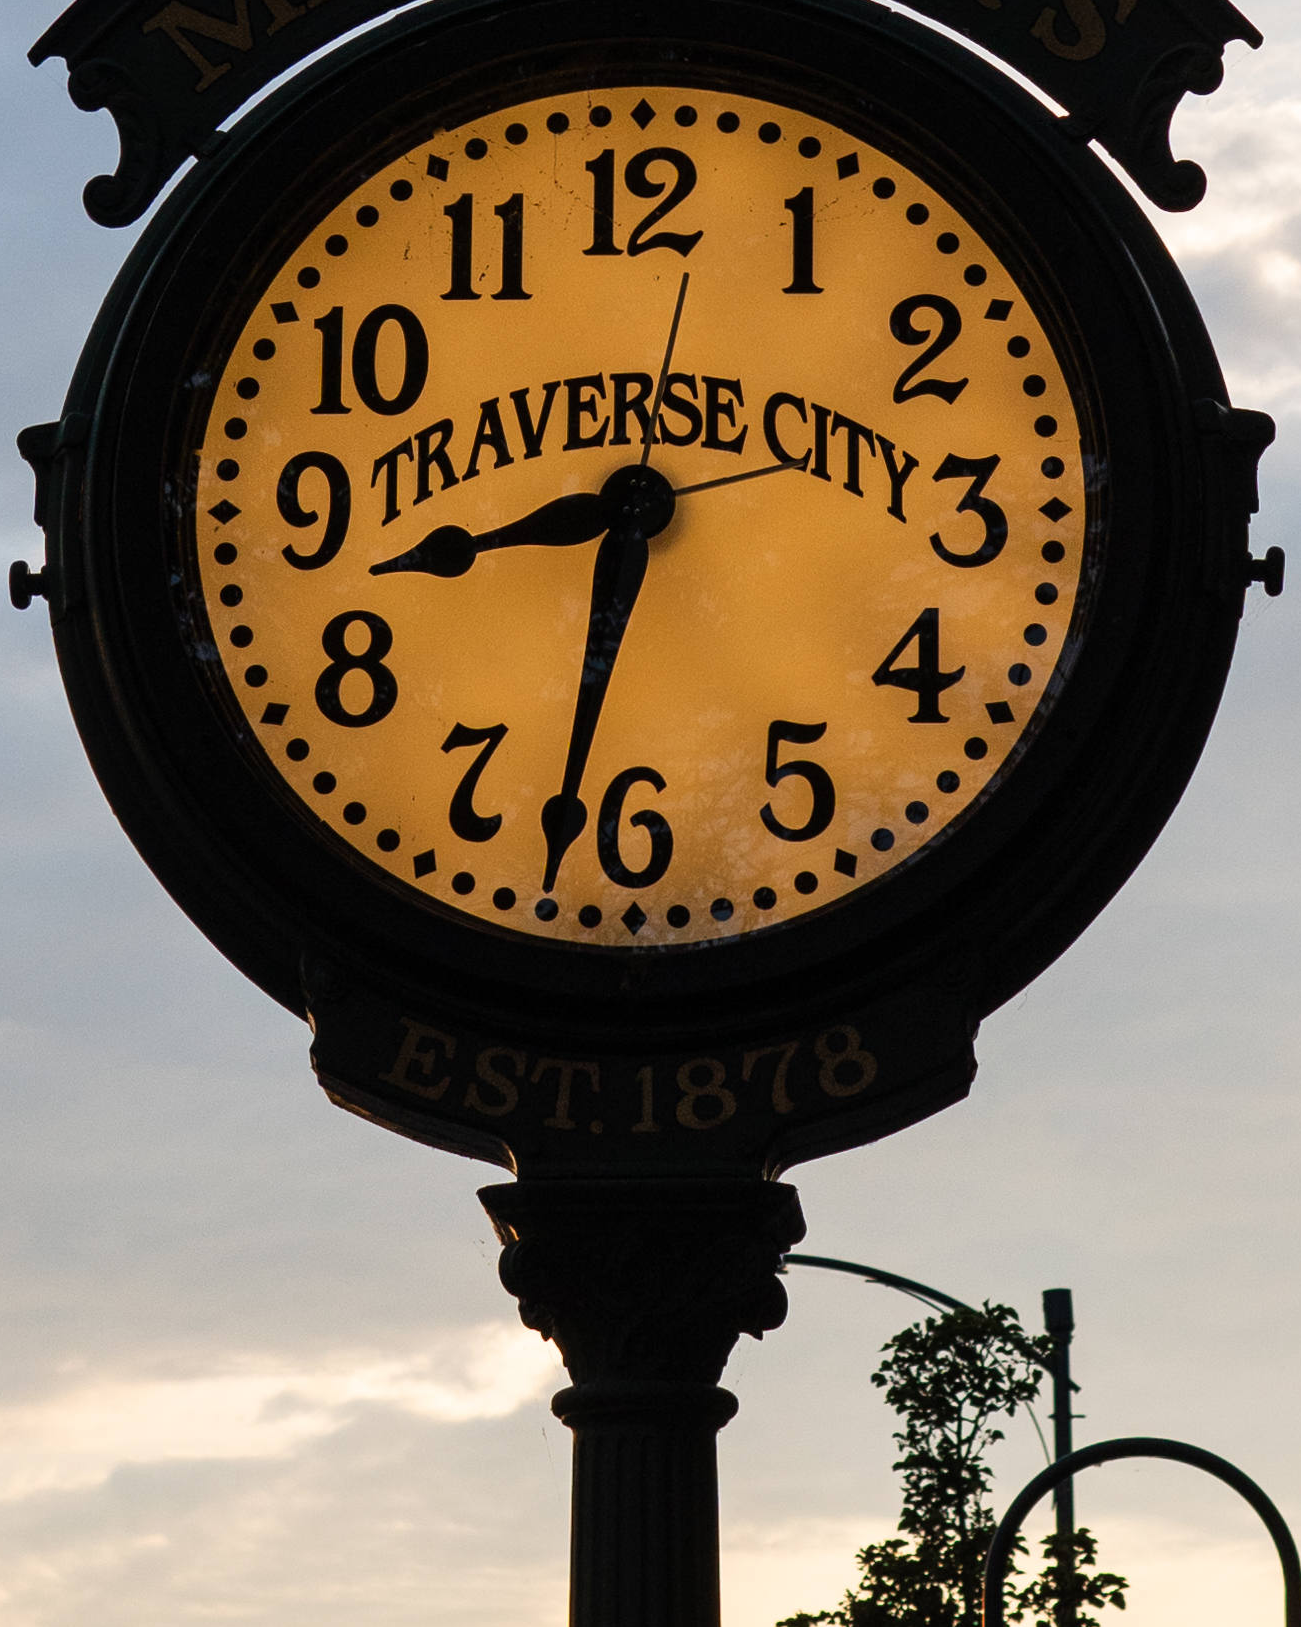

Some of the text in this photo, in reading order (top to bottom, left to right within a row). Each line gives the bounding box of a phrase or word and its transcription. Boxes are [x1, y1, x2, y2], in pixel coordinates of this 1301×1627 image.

[440, 193, 533, 300] 11
[582, 147, 703, 258] 12
[782, 187, 824, 294] 1
[310, 304, 430, 416] 10
[890, 294, 970, 405] 2
[370, 371, 920, 527] TRAVERSE CITY
[276, 451, 352, 571] 9
[929, 453, 1008, 568] 3
[314, 610, 398, 728] 8
[871, 607, 966, 724] 4
[440, 722, 509, 842] 7
[596, 767, 674, 889] 6
[760, 720, 835, 842] 5
[378, 1016, 879, 1135] EST. 1878
